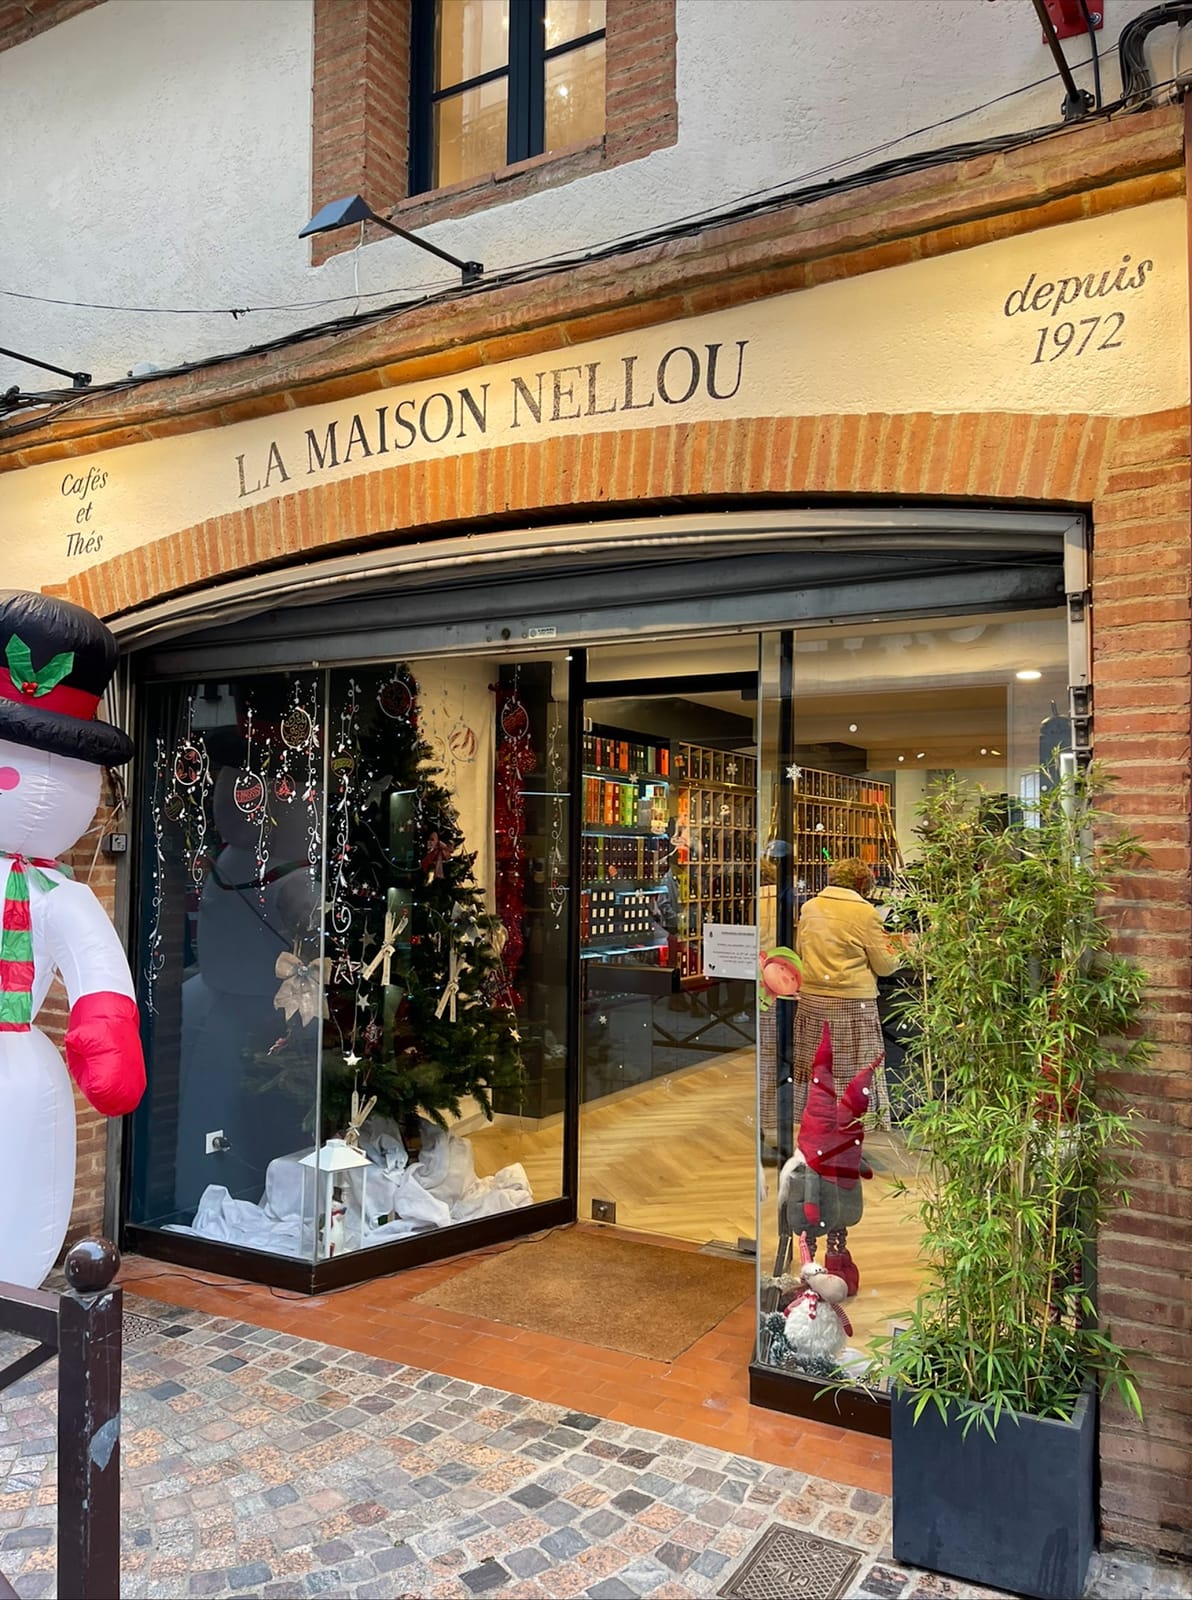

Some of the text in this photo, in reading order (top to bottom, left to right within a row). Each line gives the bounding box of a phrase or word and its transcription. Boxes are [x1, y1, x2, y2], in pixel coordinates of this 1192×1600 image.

[1003, 254, 1154, 317] depuis
[1030, 311, 1126, 365] 1972
[234, 340, 749, 498] LA MAISON NELLOU
[61, 466, 109, 501] Cafés
[76, 501, 93, 524] et
[66, 529, 104, 557] Thés
